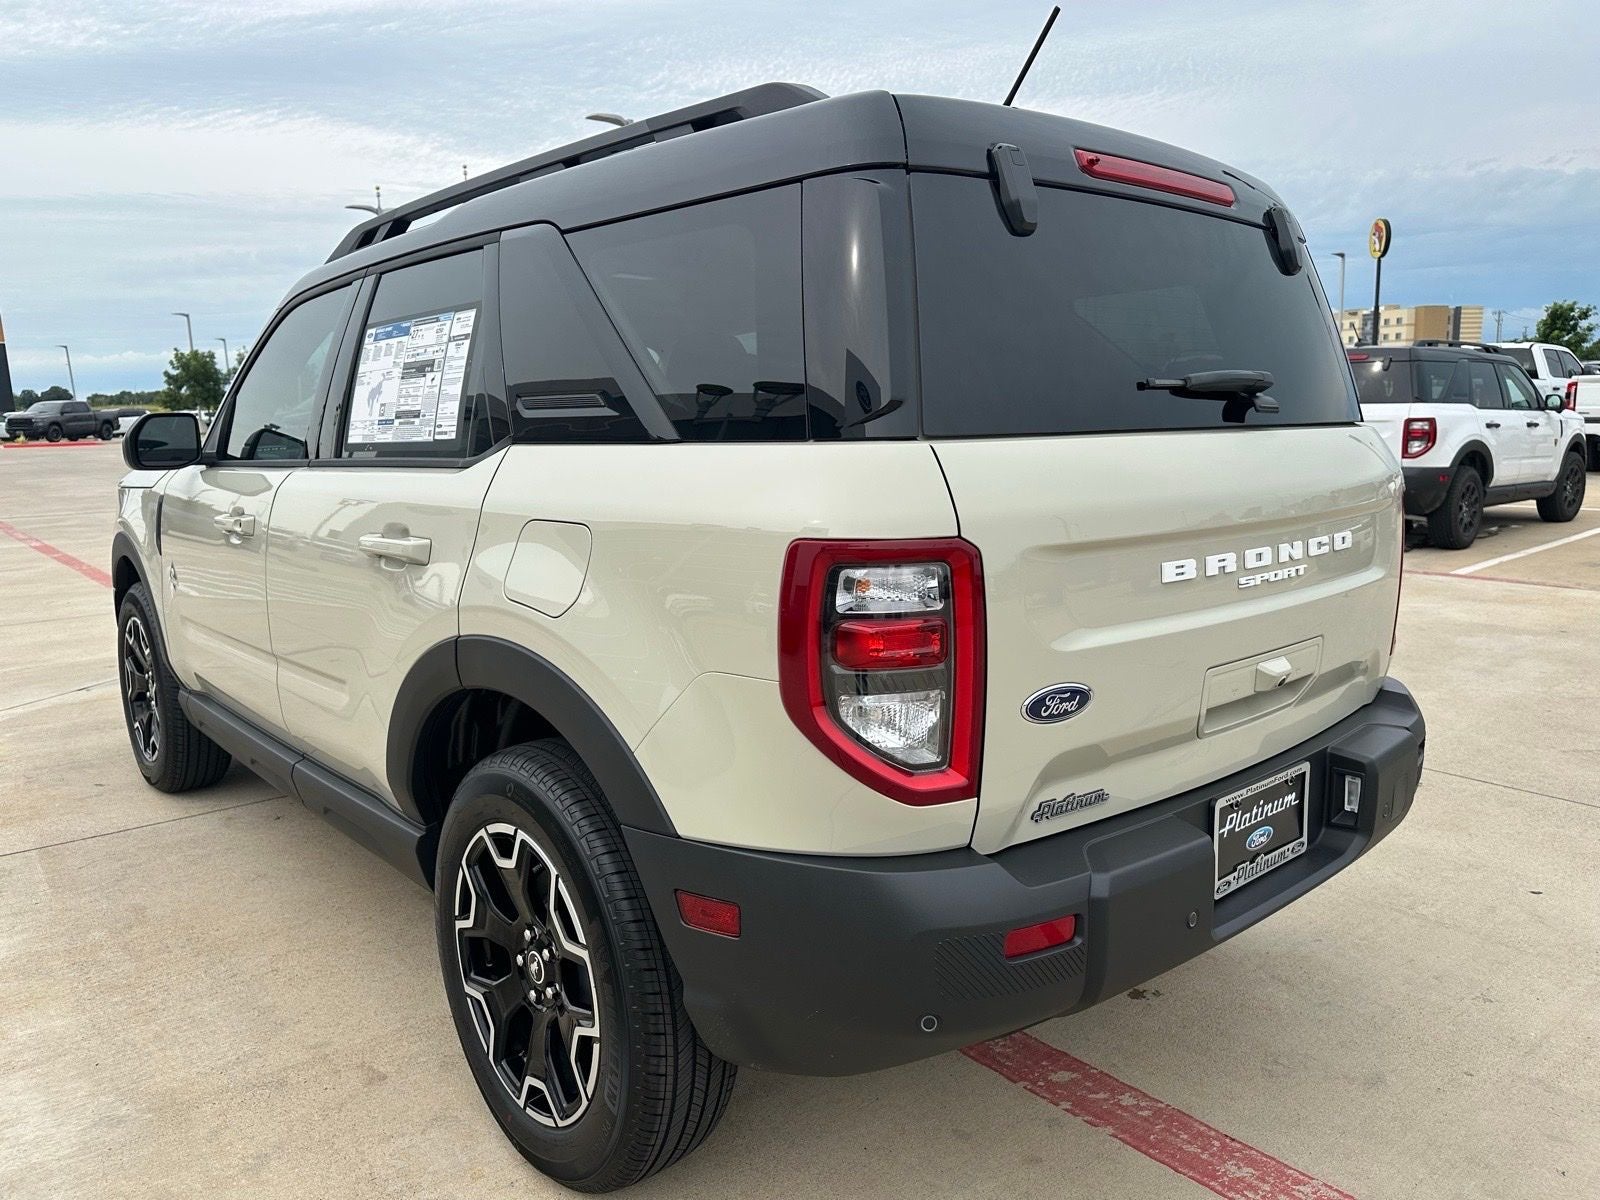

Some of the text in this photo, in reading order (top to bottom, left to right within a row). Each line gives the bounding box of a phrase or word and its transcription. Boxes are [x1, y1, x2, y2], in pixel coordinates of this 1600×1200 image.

[1161, 530, 1353, 583] BRONCO
[1238, 564, 1308, 588] SPORT
[1225, 766, 1303, 804] www.PlatinumFord.com
[1030, 788, 1110, 822] Platinum
[1219, 791, 1300, 838] Platinum
[1235, 848, 1289, 885] Platinum
